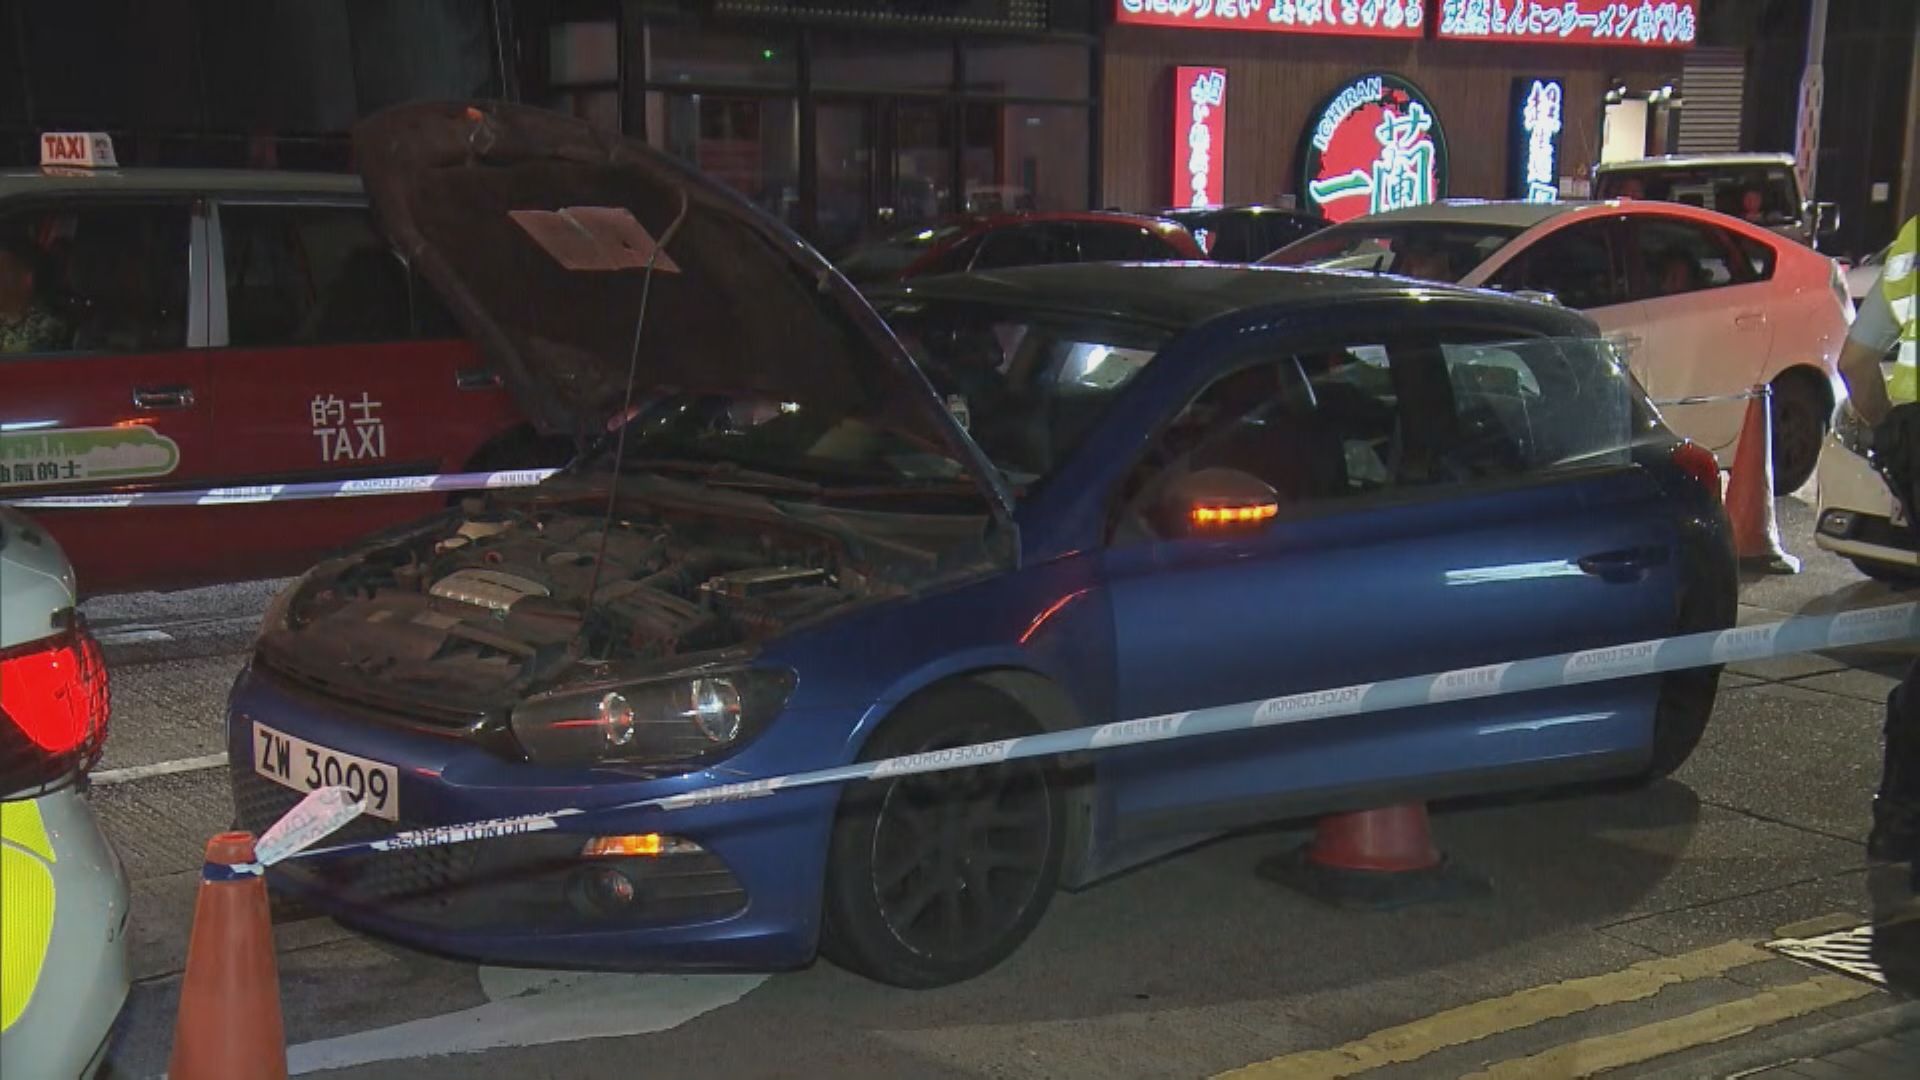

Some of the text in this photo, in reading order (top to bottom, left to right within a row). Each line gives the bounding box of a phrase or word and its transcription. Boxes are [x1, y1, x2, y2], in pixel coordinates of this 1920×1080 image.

[1313, 77, 1382, 152] ICHIRAN
[45, 136, 85, 159] TAXI
[1309, 101, 1434, 214] 一蘭
[311, 392, 382, 427] 的士
[313, 424, 385, 461] TAXI
[259, 729, 388, 811] ZW 3009
